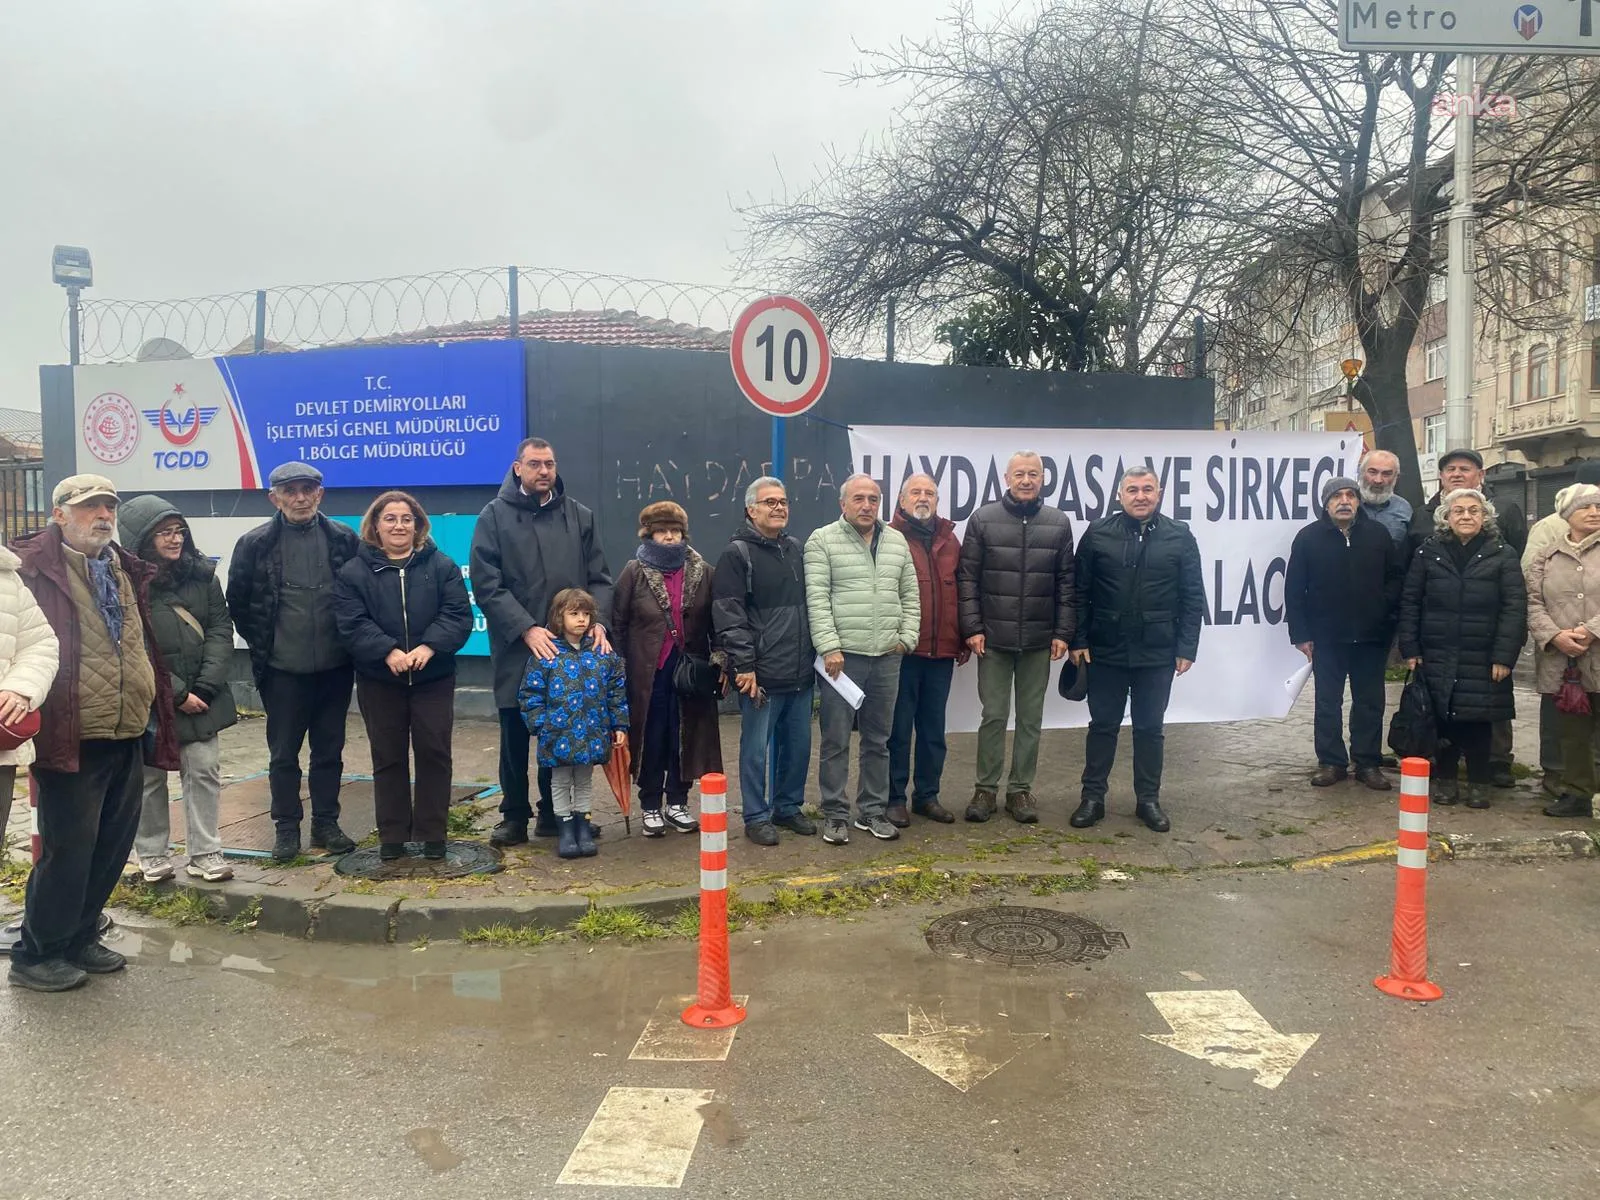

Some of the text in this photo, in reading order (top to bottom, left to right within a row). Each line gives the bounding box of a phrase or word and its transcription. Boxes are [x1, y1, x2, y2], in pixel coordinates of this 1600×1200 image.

[1352, 2, 1457, 30] Metro
[755, 325, 808, 386] 10
[363, 375, 391, 391] T.C.
[295, 394, 467, 417] DEVLET DEMİRYOLLARI
[266, 414, 501, 443] İŞLETMESİ GENEL MÜDÜRLÜĞÜ
[153, 450, 210, 469] TCDD
[298, 438, 466, 461] 1.BÖLGE MÜDÜRLÜĞÜ
[863, 453, 1125, 522] HAYDAPASA
[1144, 456, 1192, 521] VE
